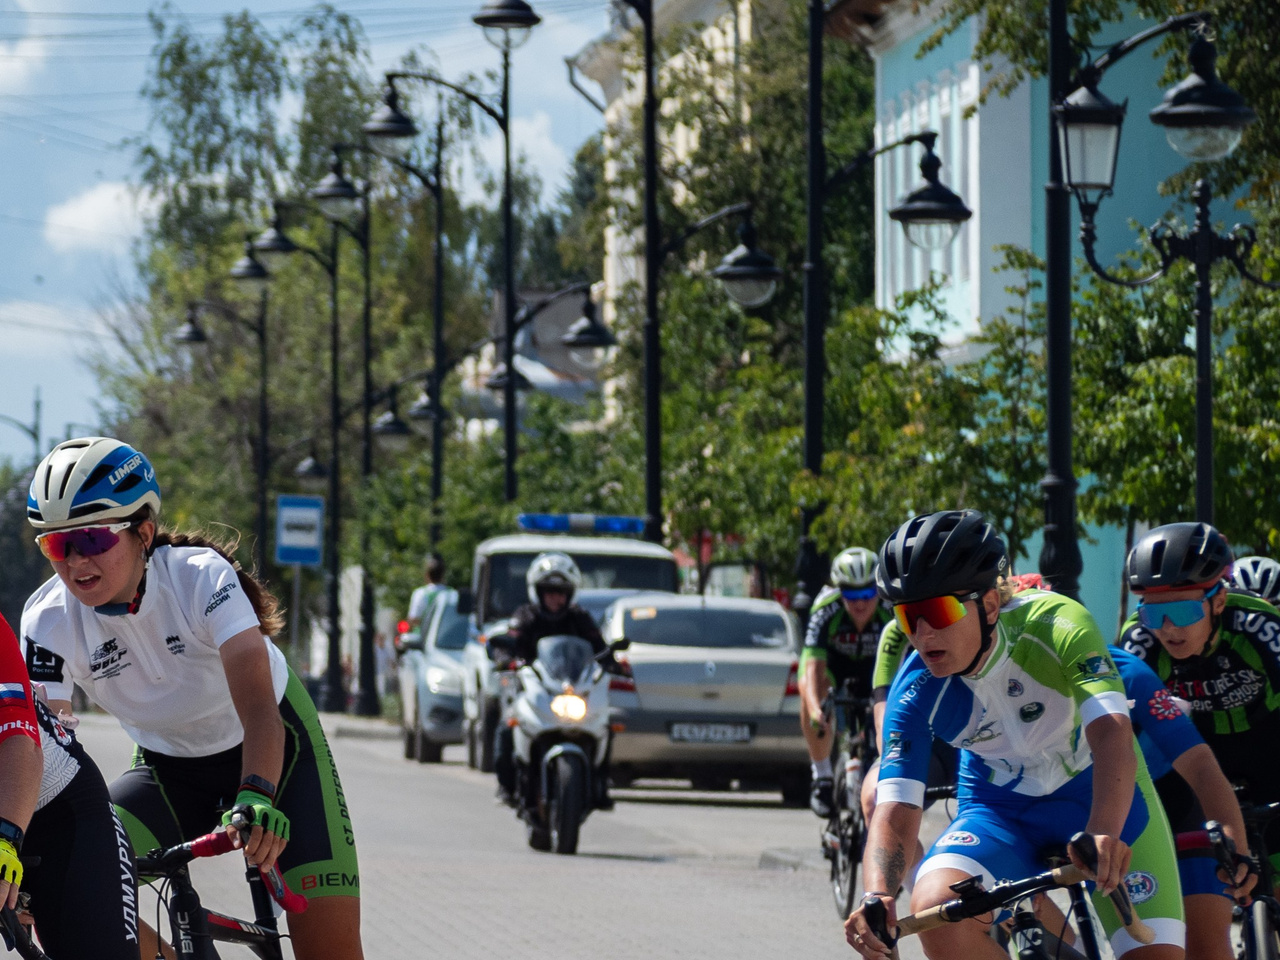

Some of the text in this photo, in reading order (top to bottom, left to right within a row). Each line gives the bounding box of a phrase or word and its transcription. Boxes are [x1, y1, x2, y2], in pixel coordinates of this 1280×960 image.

[1234, 610, 1280, 655] RUSS
[301, 873, 360, 890] BIEM
[177, 912, 193, 953] BMC
